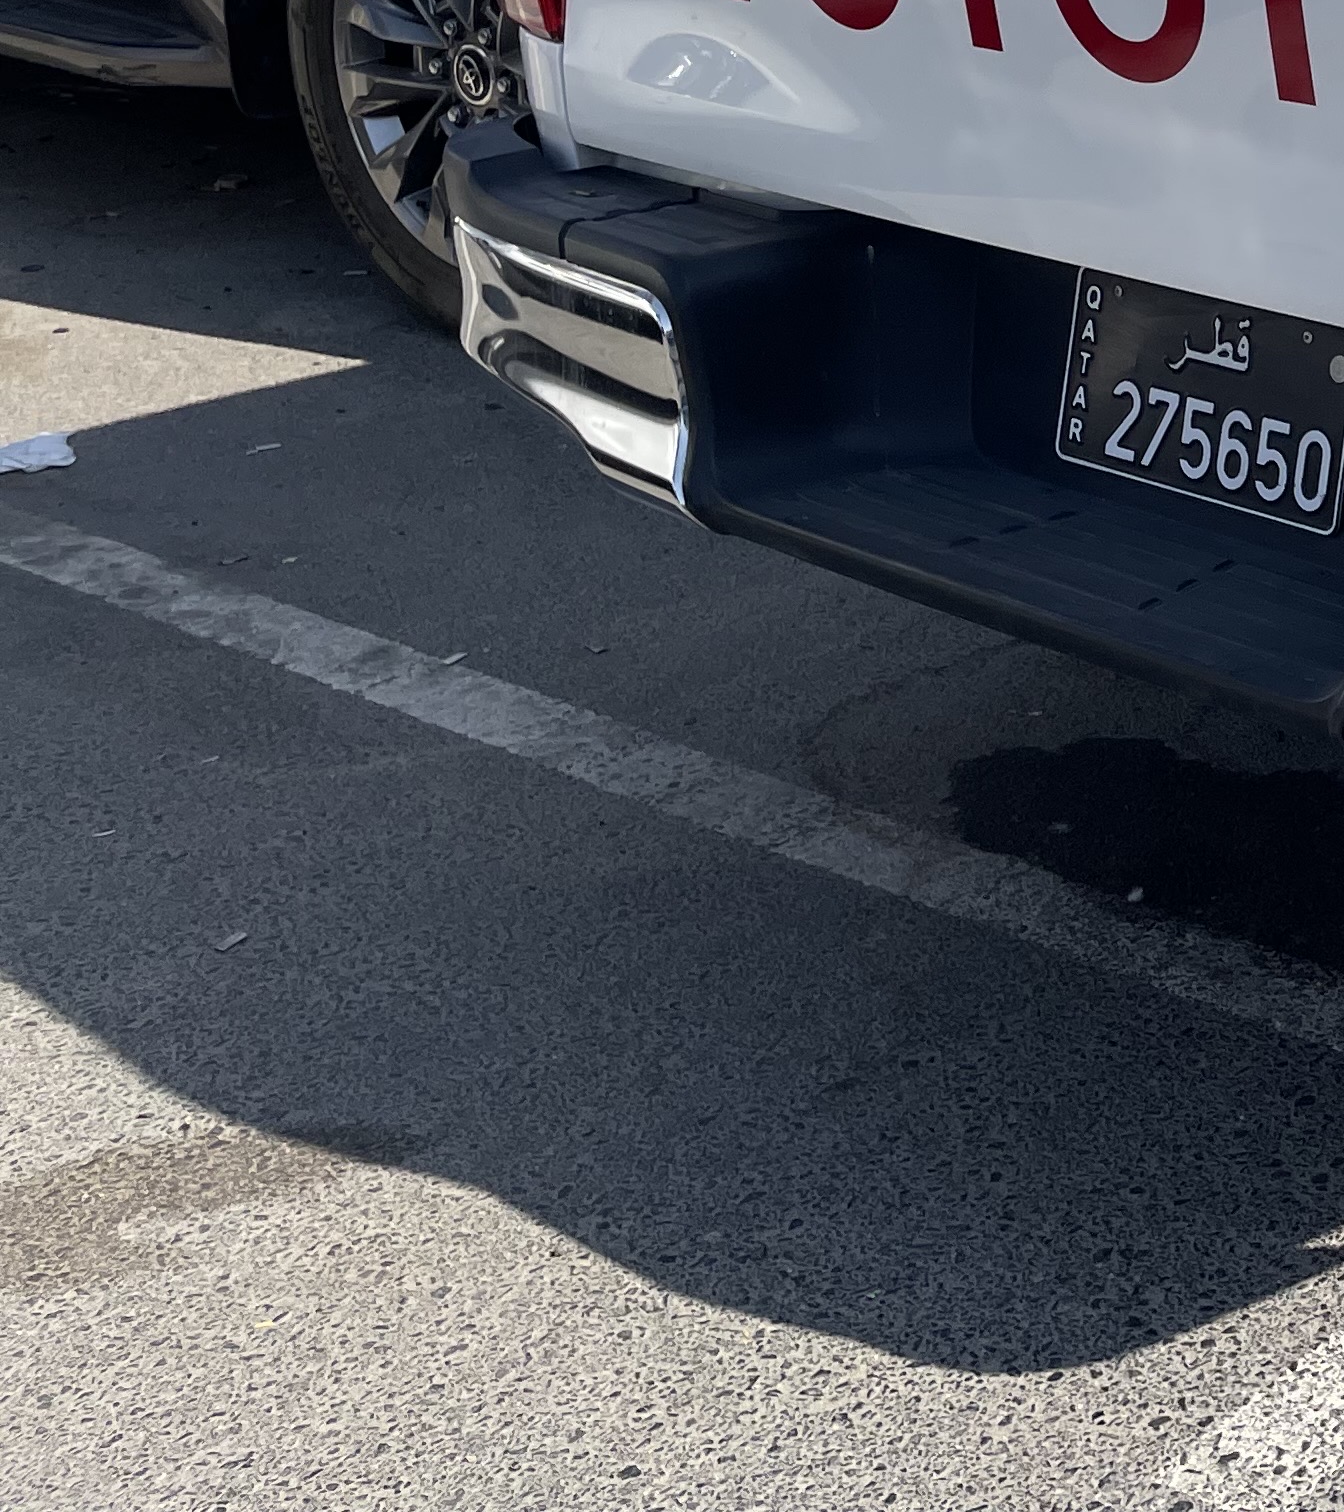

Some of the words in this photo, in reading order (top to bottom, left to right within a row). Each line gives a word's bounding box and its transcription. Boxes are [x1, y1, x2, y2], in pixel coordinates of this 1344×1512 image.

[1068, 285, 1101, 442] QATAR
[1164, 316, 1250, 372] قطر
[1104, 380, 1332, 512] 275650
